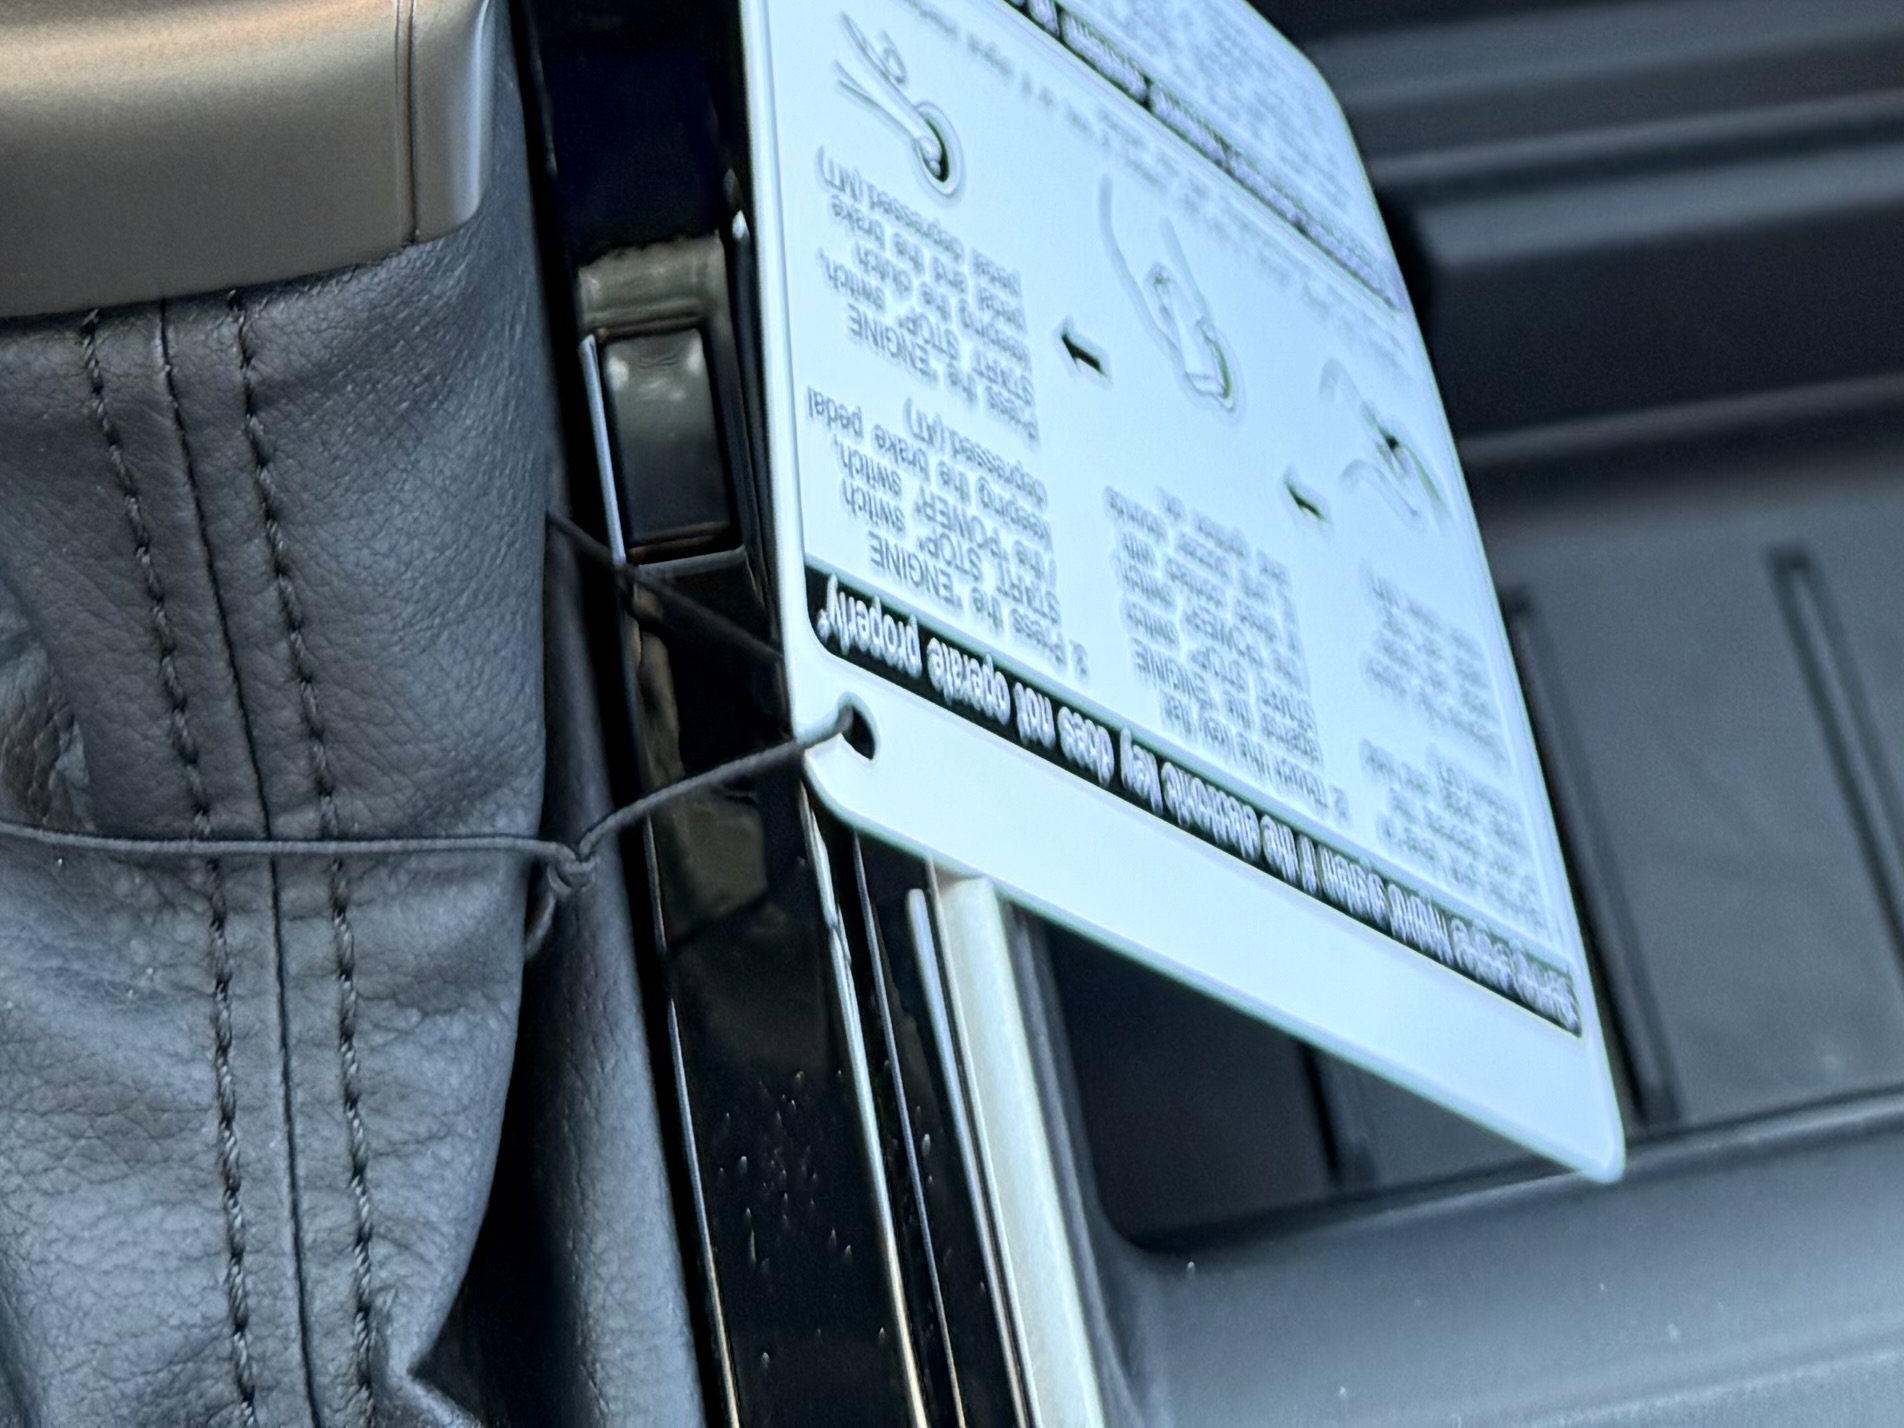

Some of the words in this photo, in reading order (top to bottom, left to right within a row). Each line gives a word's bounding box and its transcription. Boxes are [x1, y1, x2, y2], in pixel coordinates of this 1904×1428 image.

[806, 388, 864, 439] pedal
[873, 424, 931, 482] brake
[937, 460, 971, 505] the
[841, 480, 906, 534] switch
[977, 476, 1053, 551] keeping
[971, 585, 1004, 631] the
[995, 561, 1061, 626] START
[1010, 607, 1067, 666] Press
[925, 620, 1011, 720] operate
[1013, 682, 1056, 745] not
[1057, 707, 1115, 780] does
[1113, 722, 1163, 807] key
